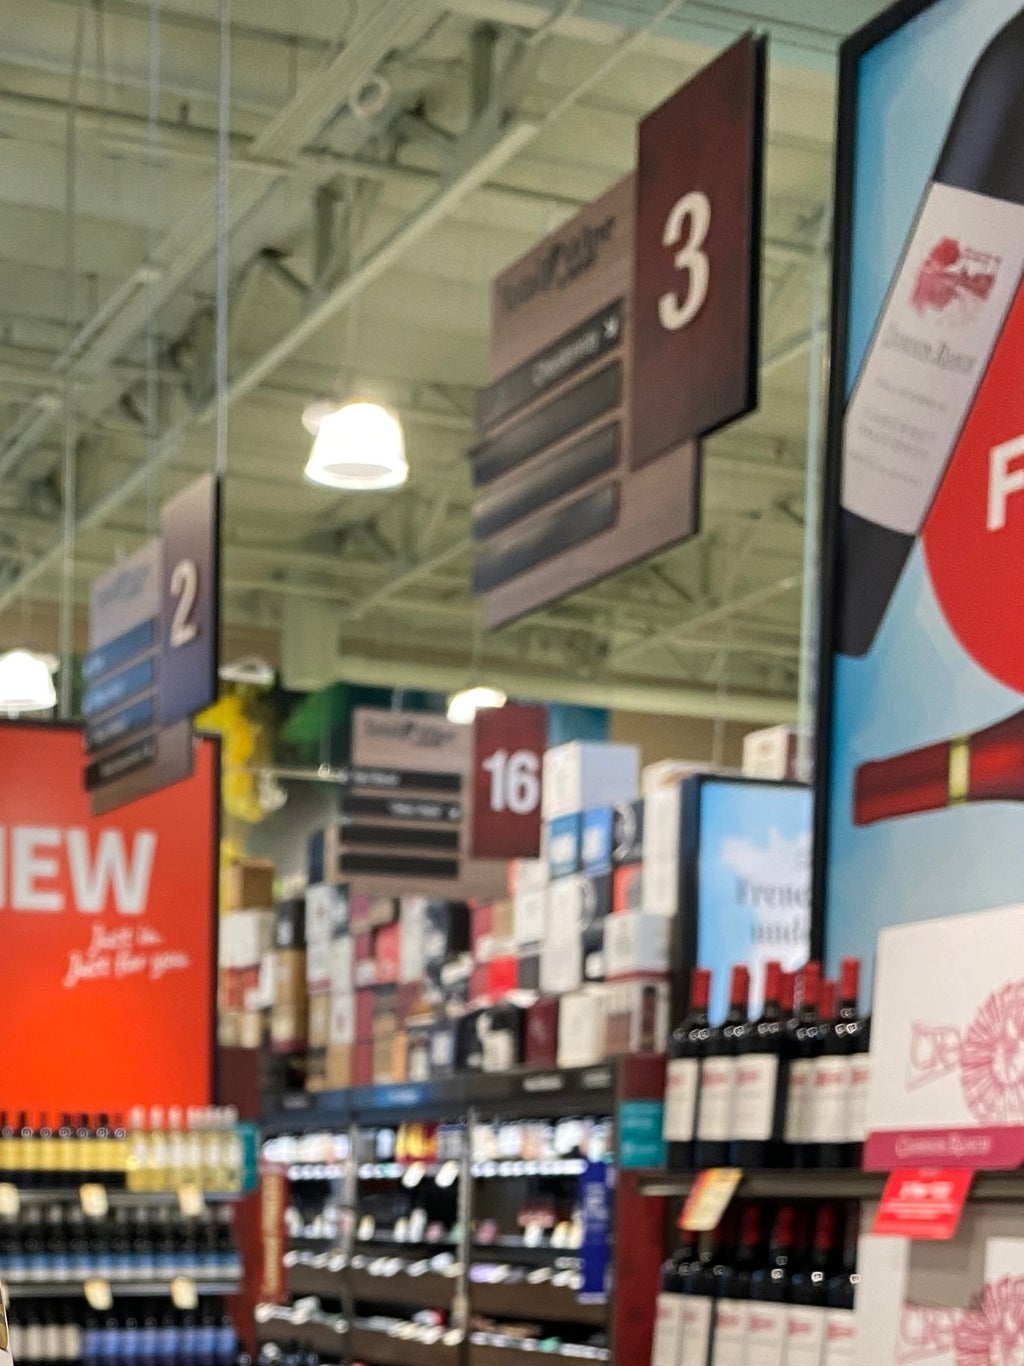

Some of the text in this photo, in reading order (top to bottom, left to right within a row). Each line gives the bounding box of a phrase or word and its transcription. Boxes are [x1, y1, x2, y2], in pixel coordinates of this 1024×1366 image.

[658, 191, 712, 331] 3
[170, 559, 198, 647] 2
[482, 749, 540, 814] 16
